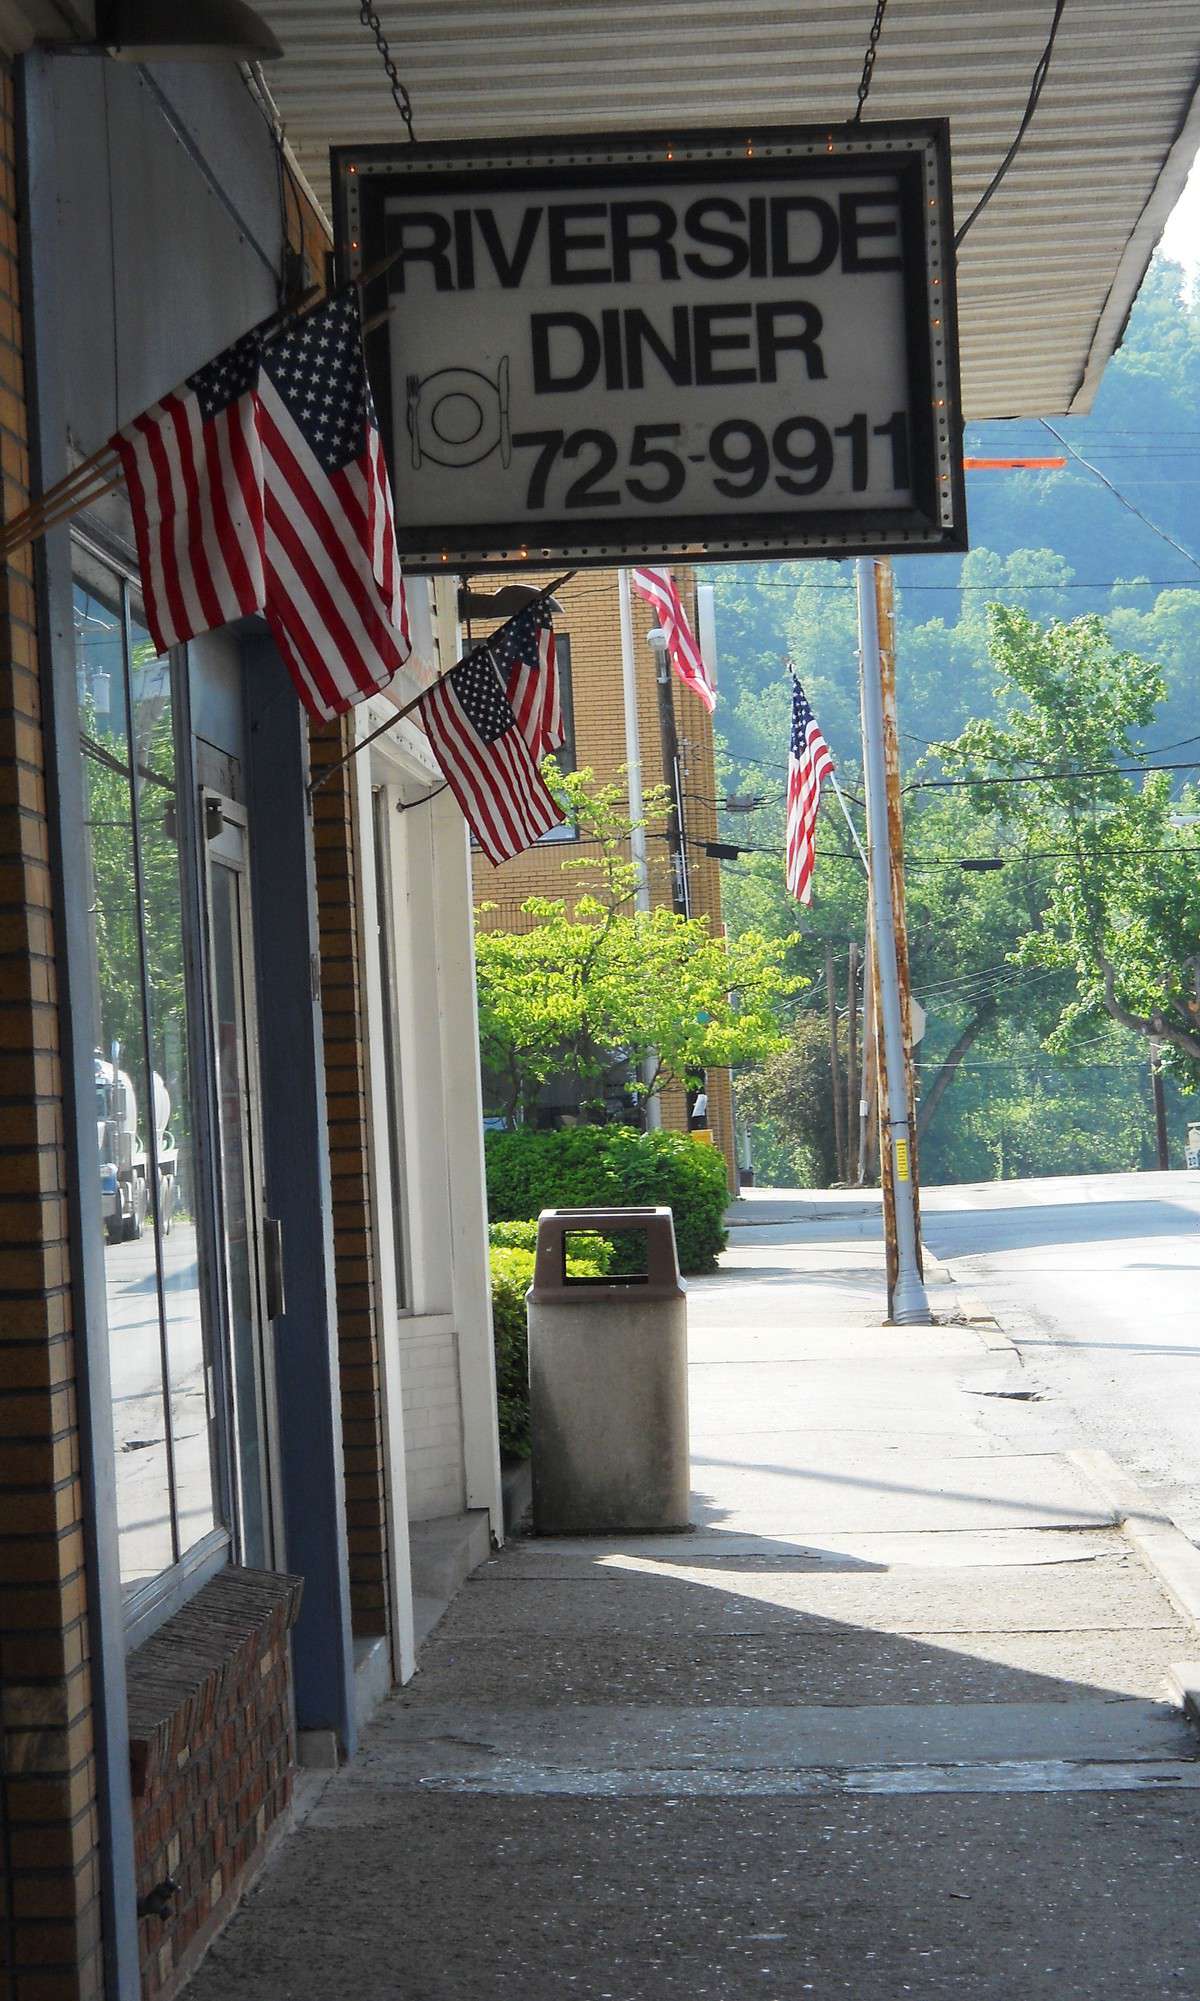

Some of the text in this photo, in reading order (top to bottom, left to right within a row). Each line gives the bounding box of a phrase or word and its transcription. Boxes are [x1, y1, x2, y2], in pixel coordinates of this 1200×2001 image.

[387, 192, 900, 293] RIVERSIDE
[530, 301, 829, 394] DINER
[511, 412, 909, 509] 725-9911
